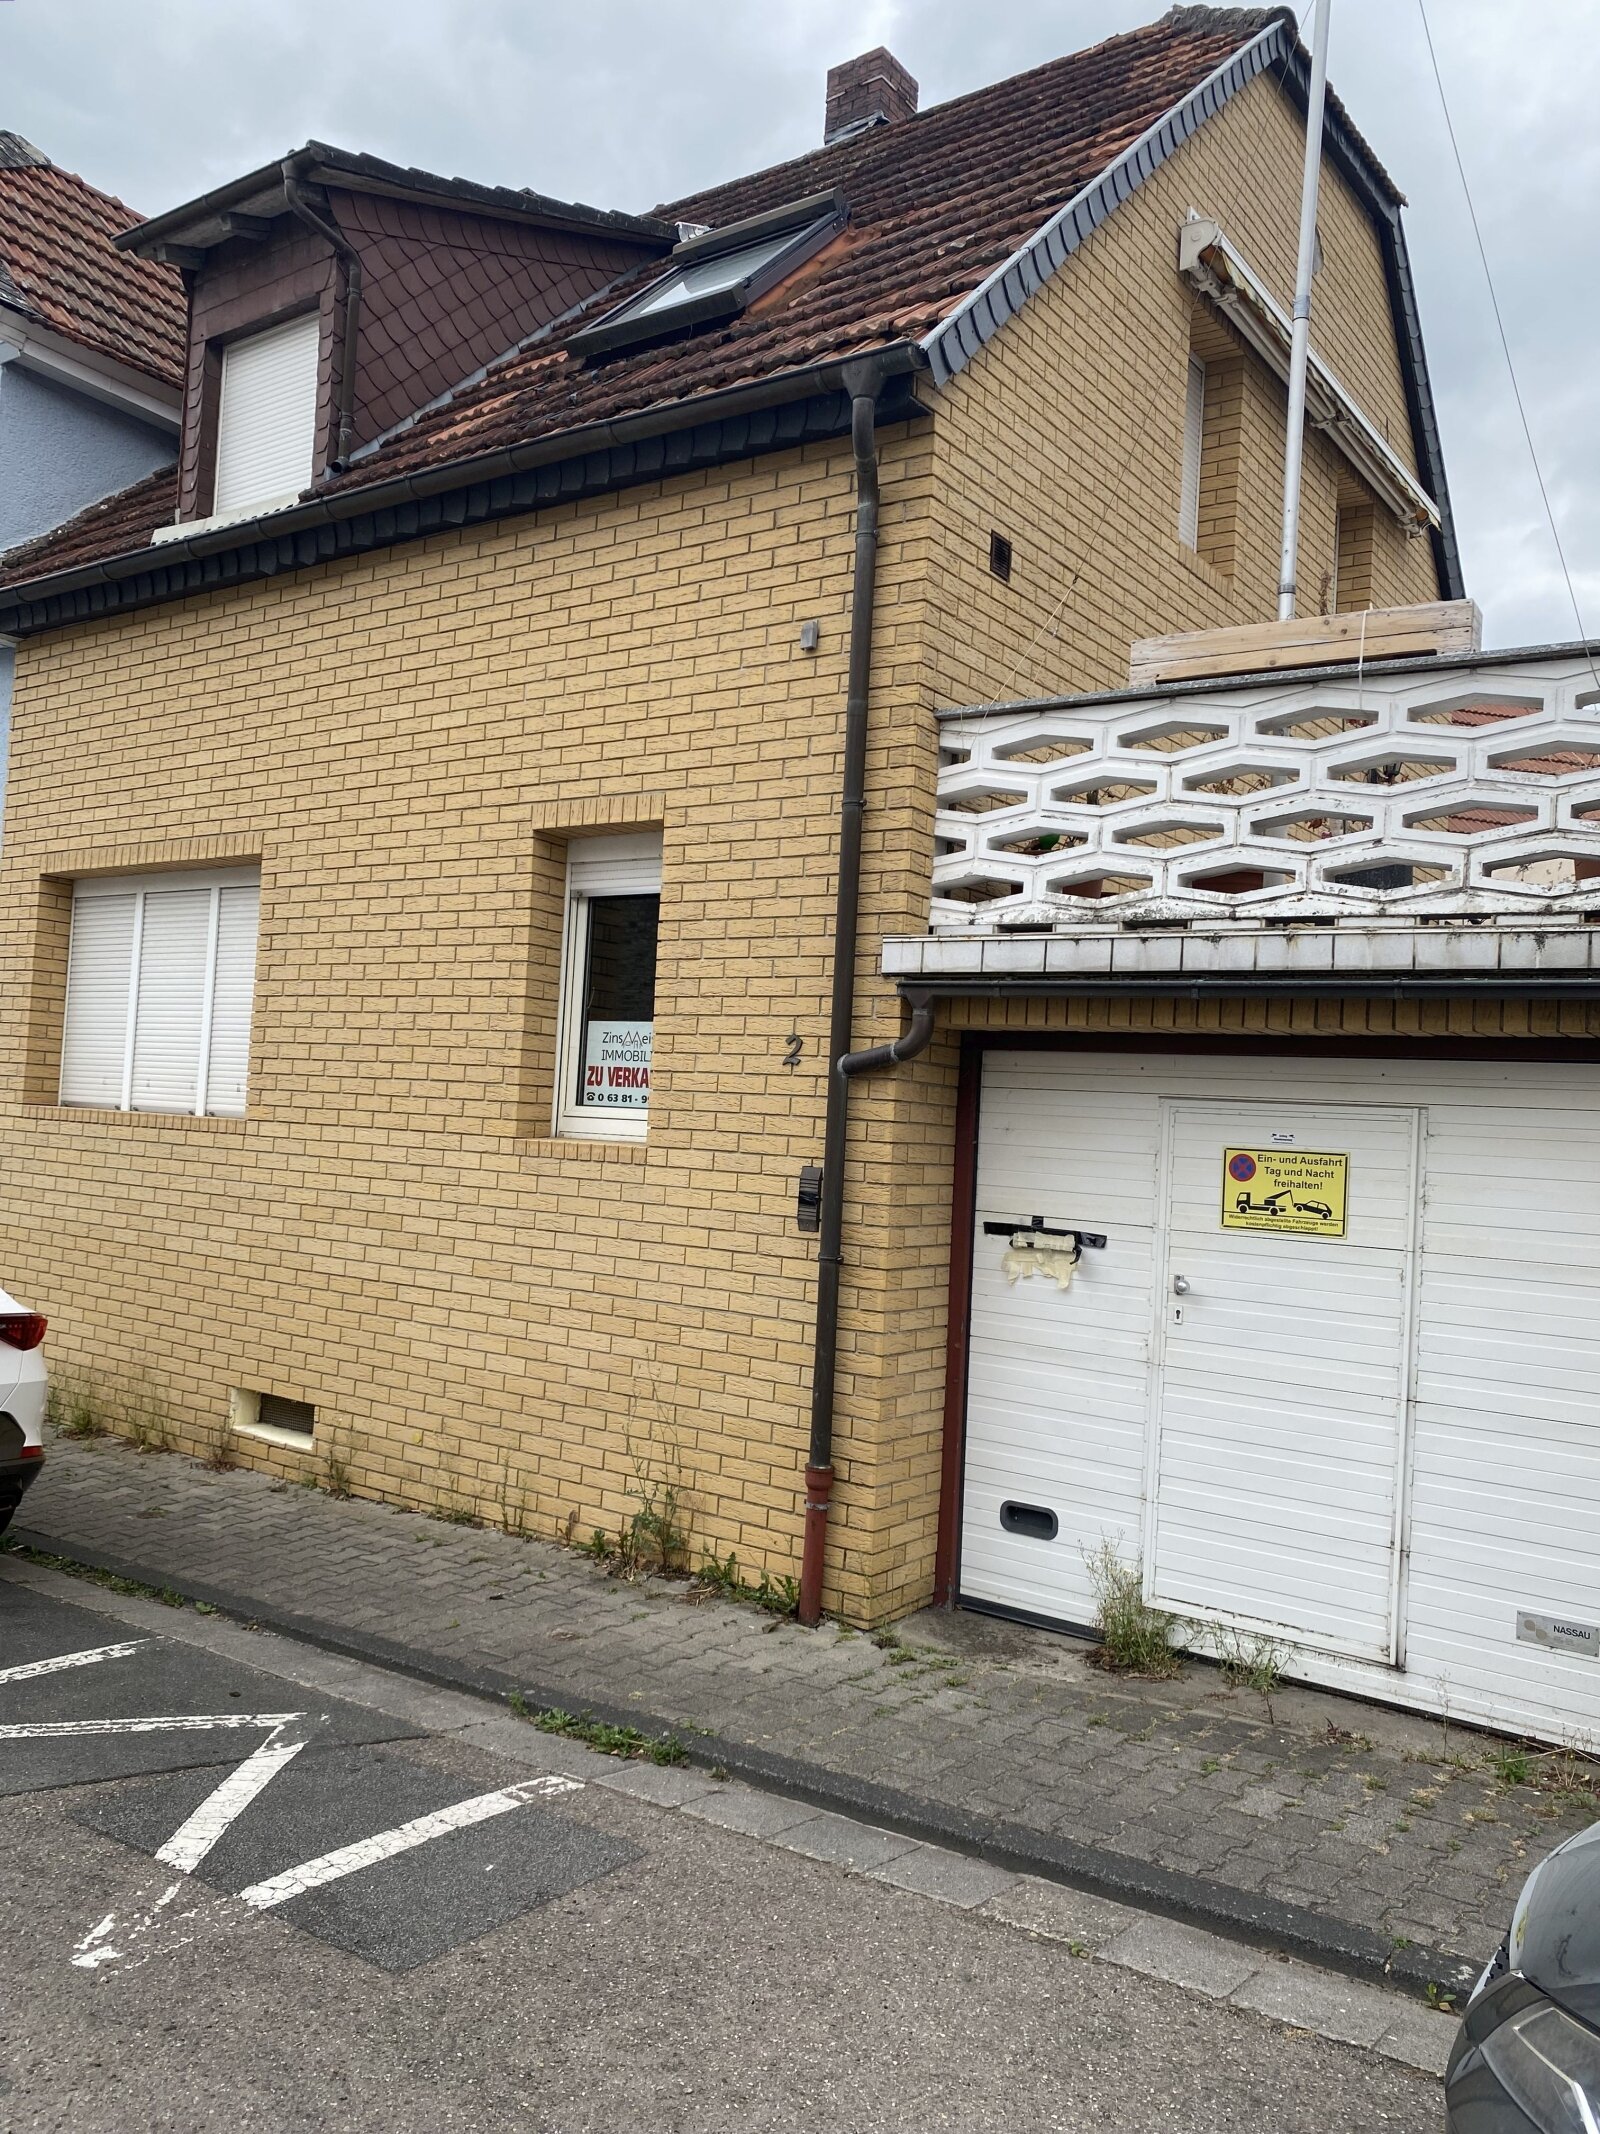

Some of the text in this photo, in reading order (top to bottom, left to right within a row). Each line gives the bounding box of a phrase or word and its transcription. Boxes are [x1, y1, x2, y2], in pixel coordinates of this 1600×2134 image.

[602, 1030, 653, 1049] ZinsMei
[601, 1049, 653, 1062] IMMOBIL
[782, 1033, 803, 1066] 2
[587, 1065, 650, 1088] ZU VERKA
[597, 1093, 604, 1102] 0
[607, 1093, 619, 1103] 63
[621, 1094, 632, 1103] 81
[641, 1095, 650, 1104] 9
[1257, 1154, 1343, 1167] Ein- und Ausfahrt
[1264, 1166, 1335, 1179] Tag und Nacht
[1273, 1179, 1323, 1190] freihalten!
[1553, 1625, 1591, 1640] NASSAU
